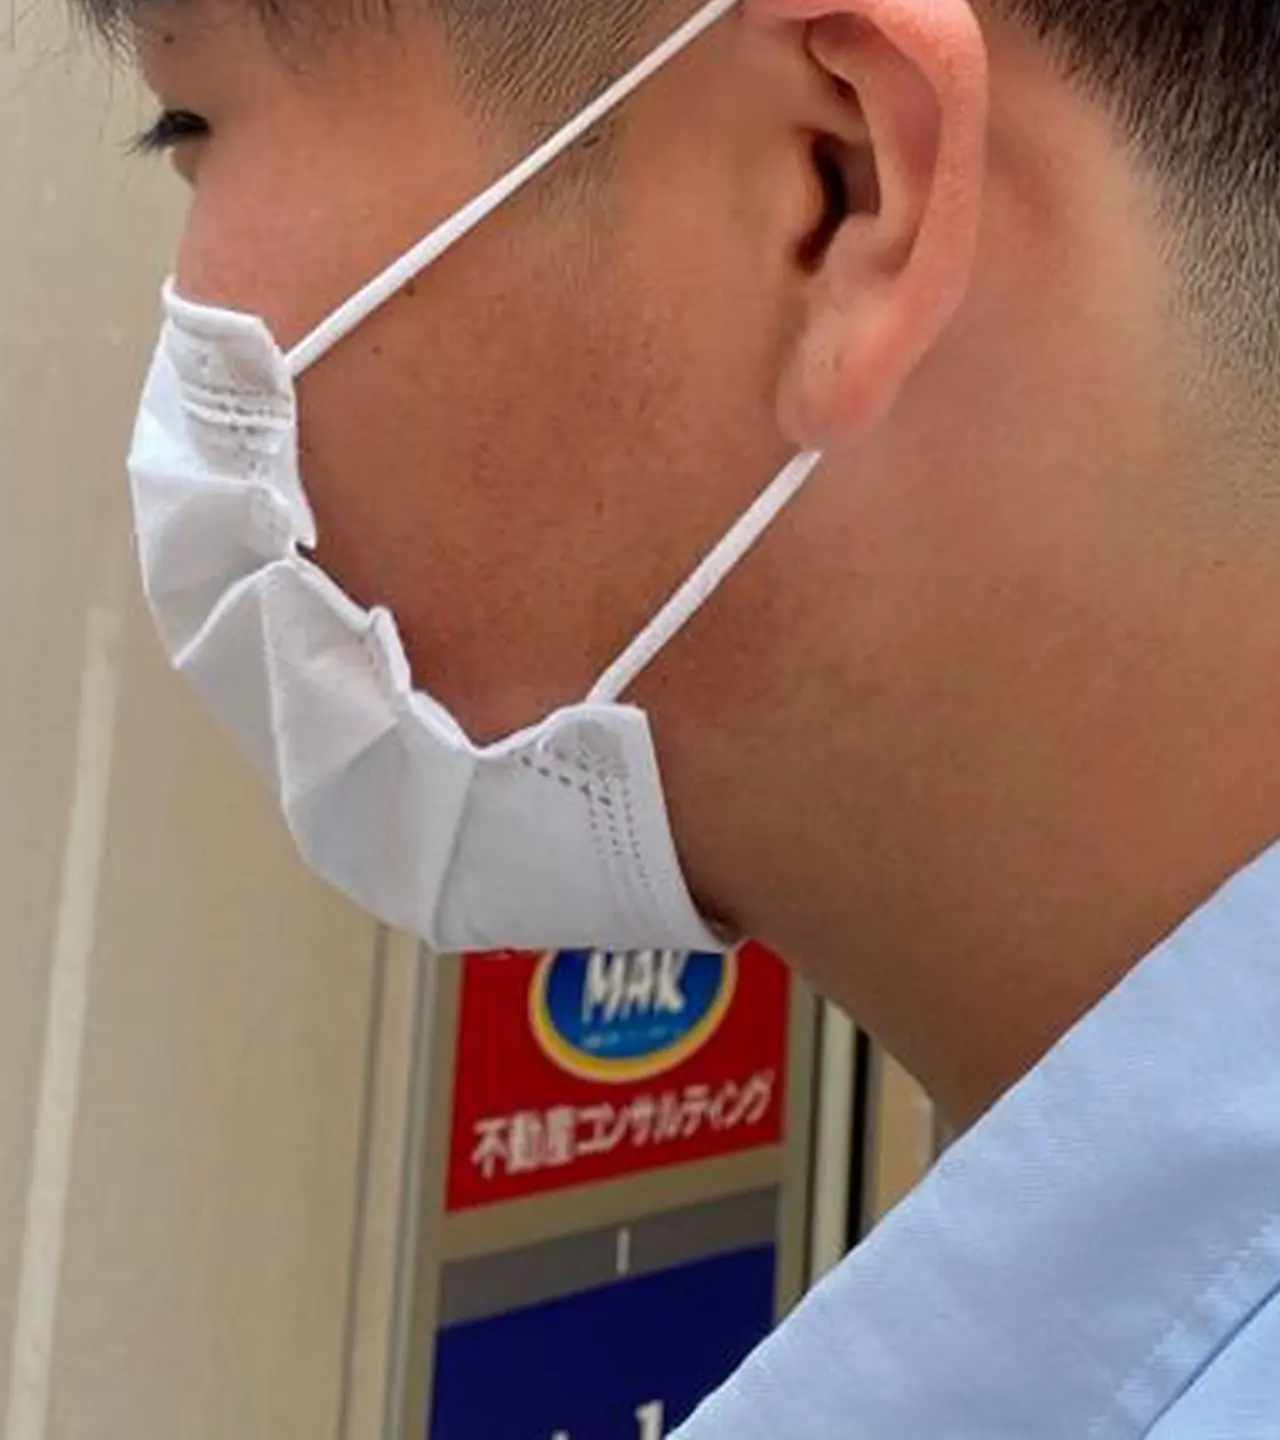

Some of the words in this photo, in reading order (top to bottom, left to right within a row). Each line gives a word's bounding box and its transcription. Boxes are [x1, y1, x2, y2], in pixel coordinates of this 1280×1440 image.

[472, 1070, 774, 1180] 不動産コンサルティング
